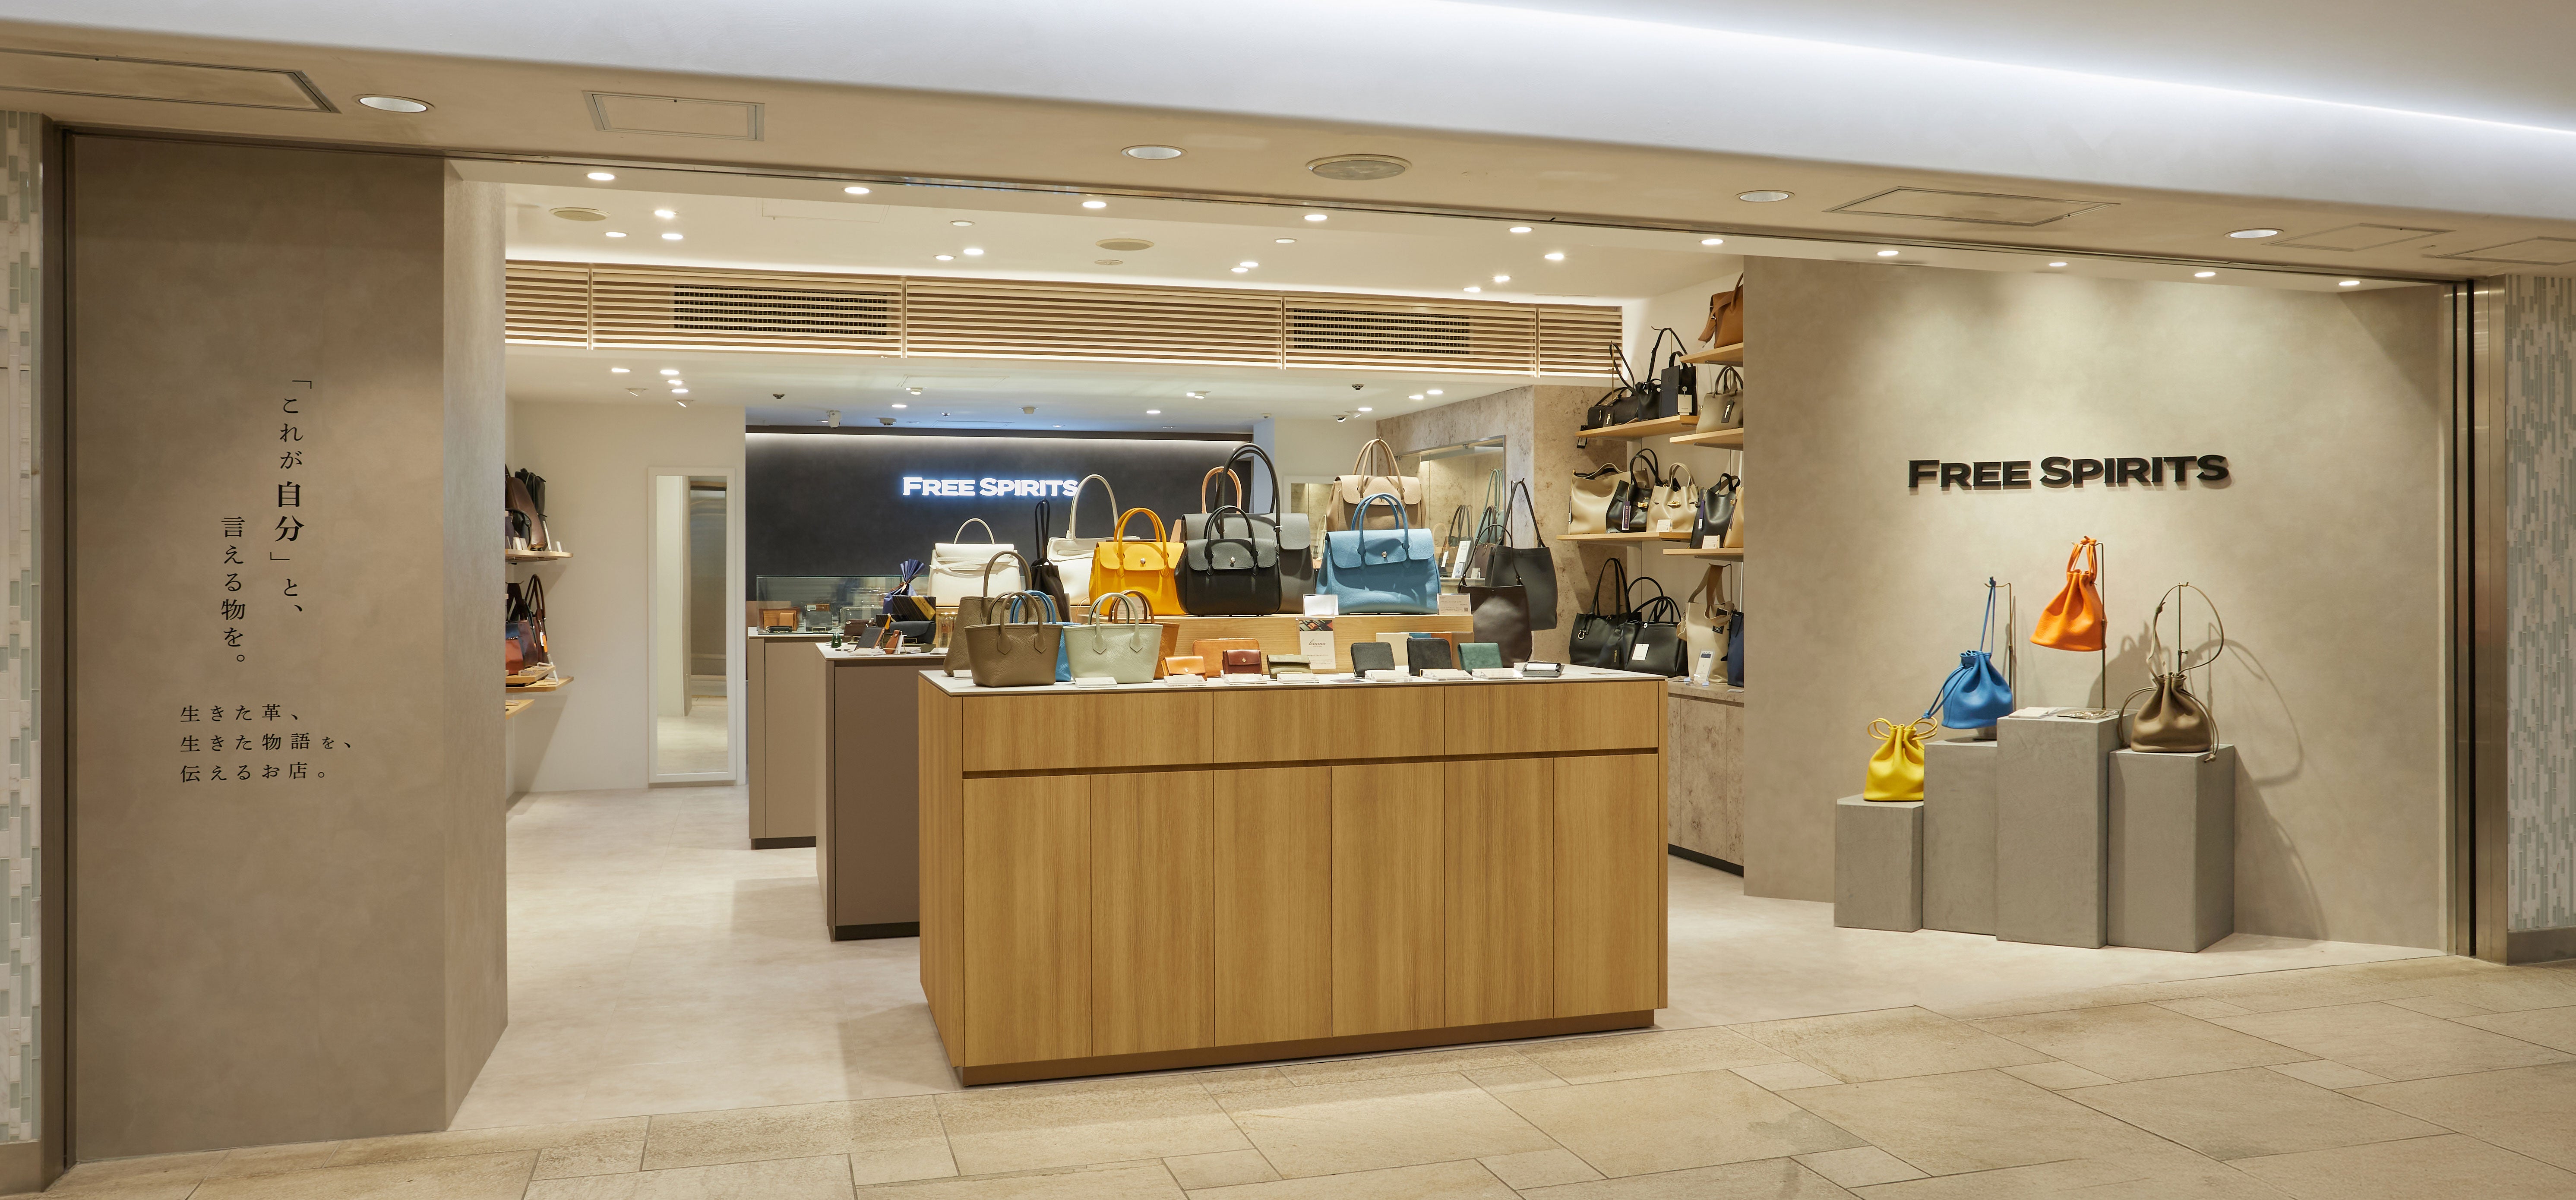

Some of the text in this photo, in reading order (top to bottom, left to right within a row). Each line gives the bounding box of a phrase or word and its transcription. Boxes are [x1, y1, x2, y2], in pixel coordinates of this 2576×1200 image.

[1908, 455, 2230, 490] FREE SPIRITS
[270, 380, 312, 612] 「これが自分」と、
[903, 477, 1078, 496] FREE SPIRITS
[221, 516, 246, 662] 言える物を。
[180, 704, 298, 722] 生きた革、
[180, 732, 351, 752] 生きた物語を、
[180, 761, 325, 783] 伝えるお店。
